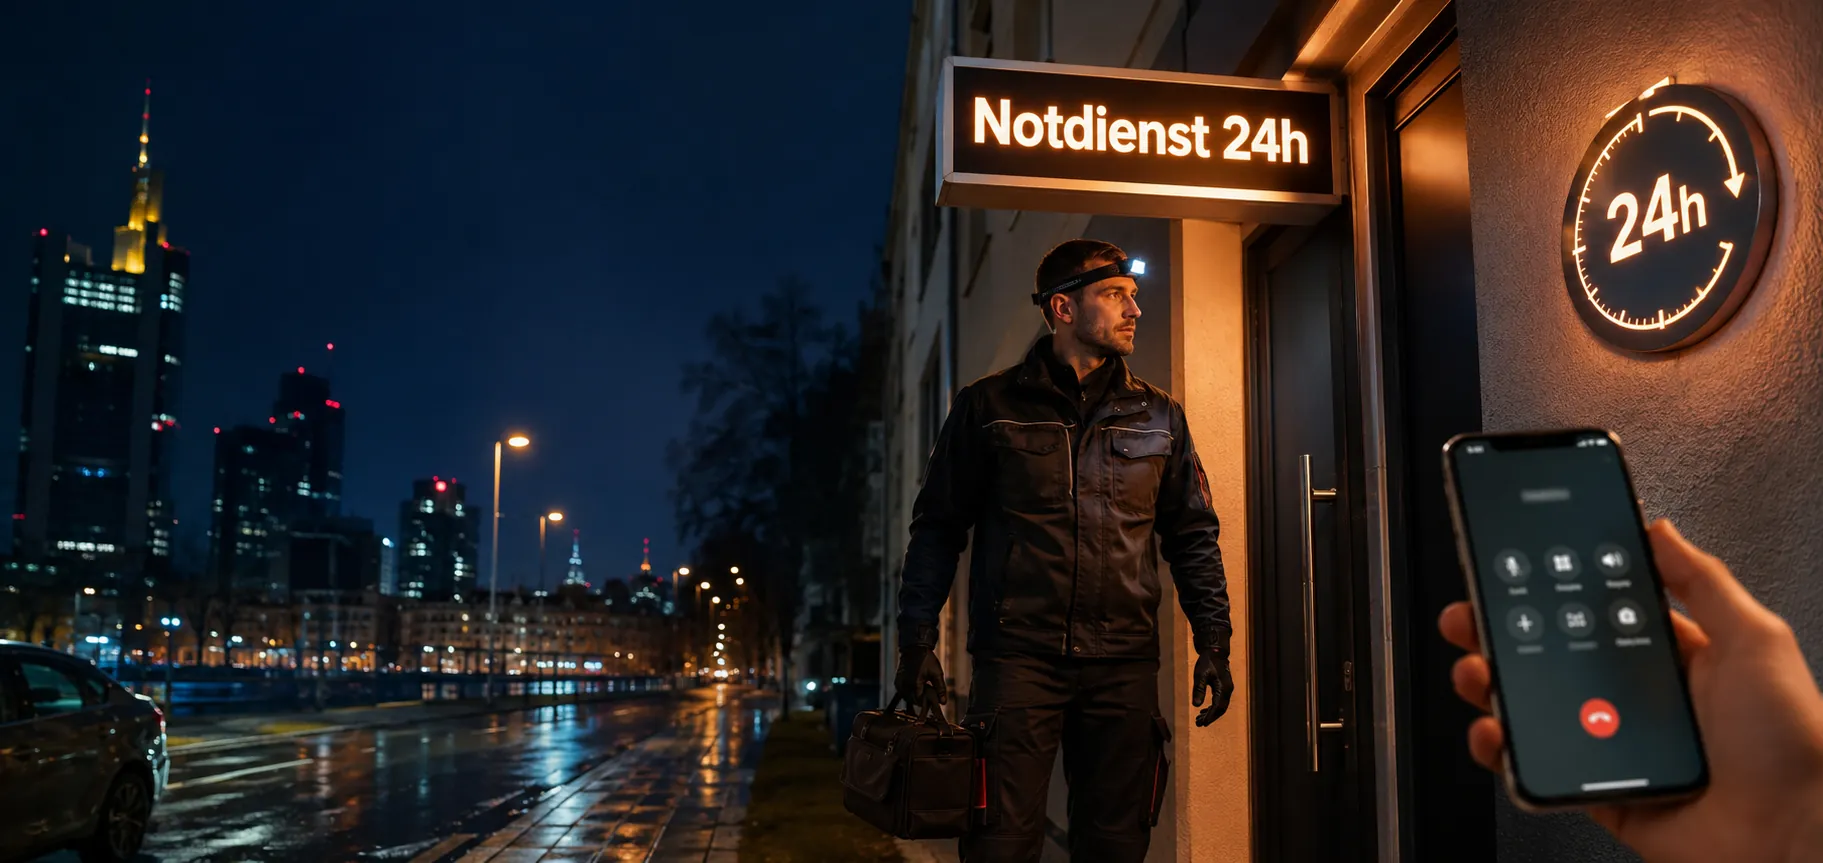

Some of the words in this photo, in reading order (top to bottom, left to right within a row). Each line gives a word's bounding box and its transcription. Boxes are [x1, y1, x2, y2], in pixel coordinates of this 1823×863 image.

[974, 96, 1210, 159] Notdienst
[1223, 114, 1309, 164] 24h
[1606, 173, 1708, 264] 24h
